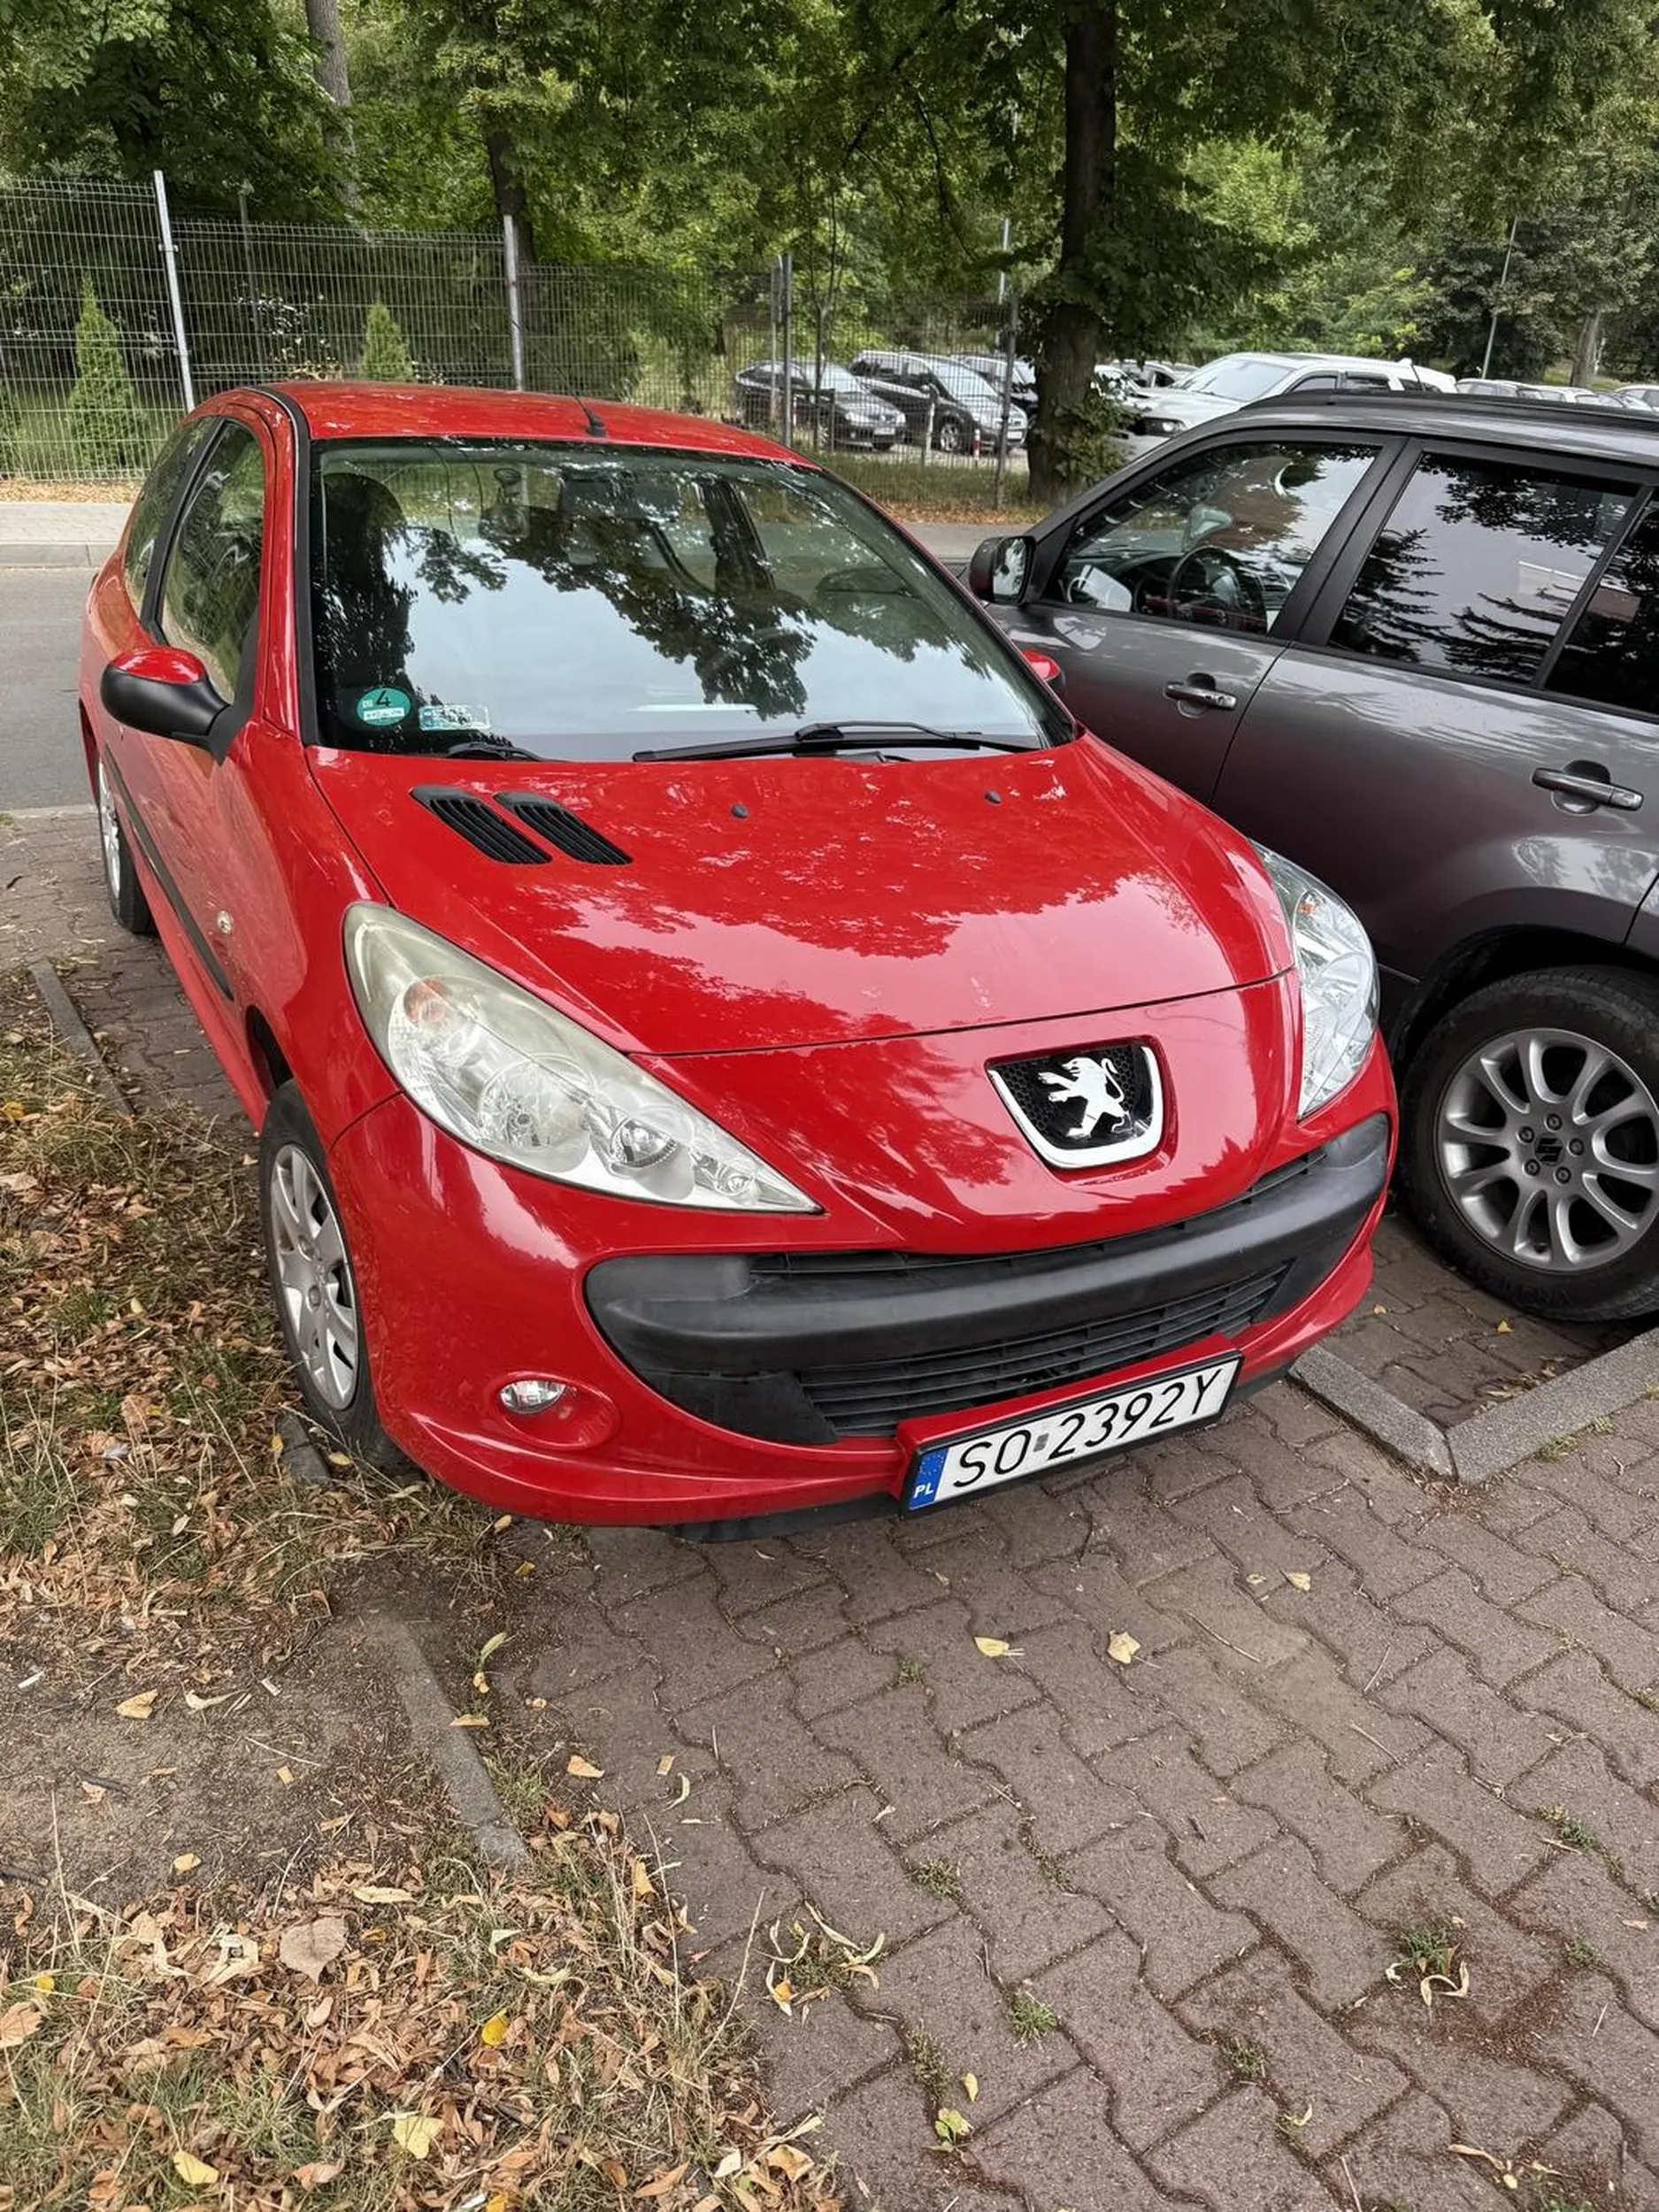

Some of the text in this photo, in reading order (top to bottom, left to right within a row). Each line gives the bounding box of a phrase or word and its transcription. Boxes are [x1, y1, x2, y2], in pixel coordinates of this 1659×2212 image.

[376, 689, 391, 707] 4
[954, 1368, 1223, 1487] SO 2392Y
[913, 1482, 934, 1499] PL
